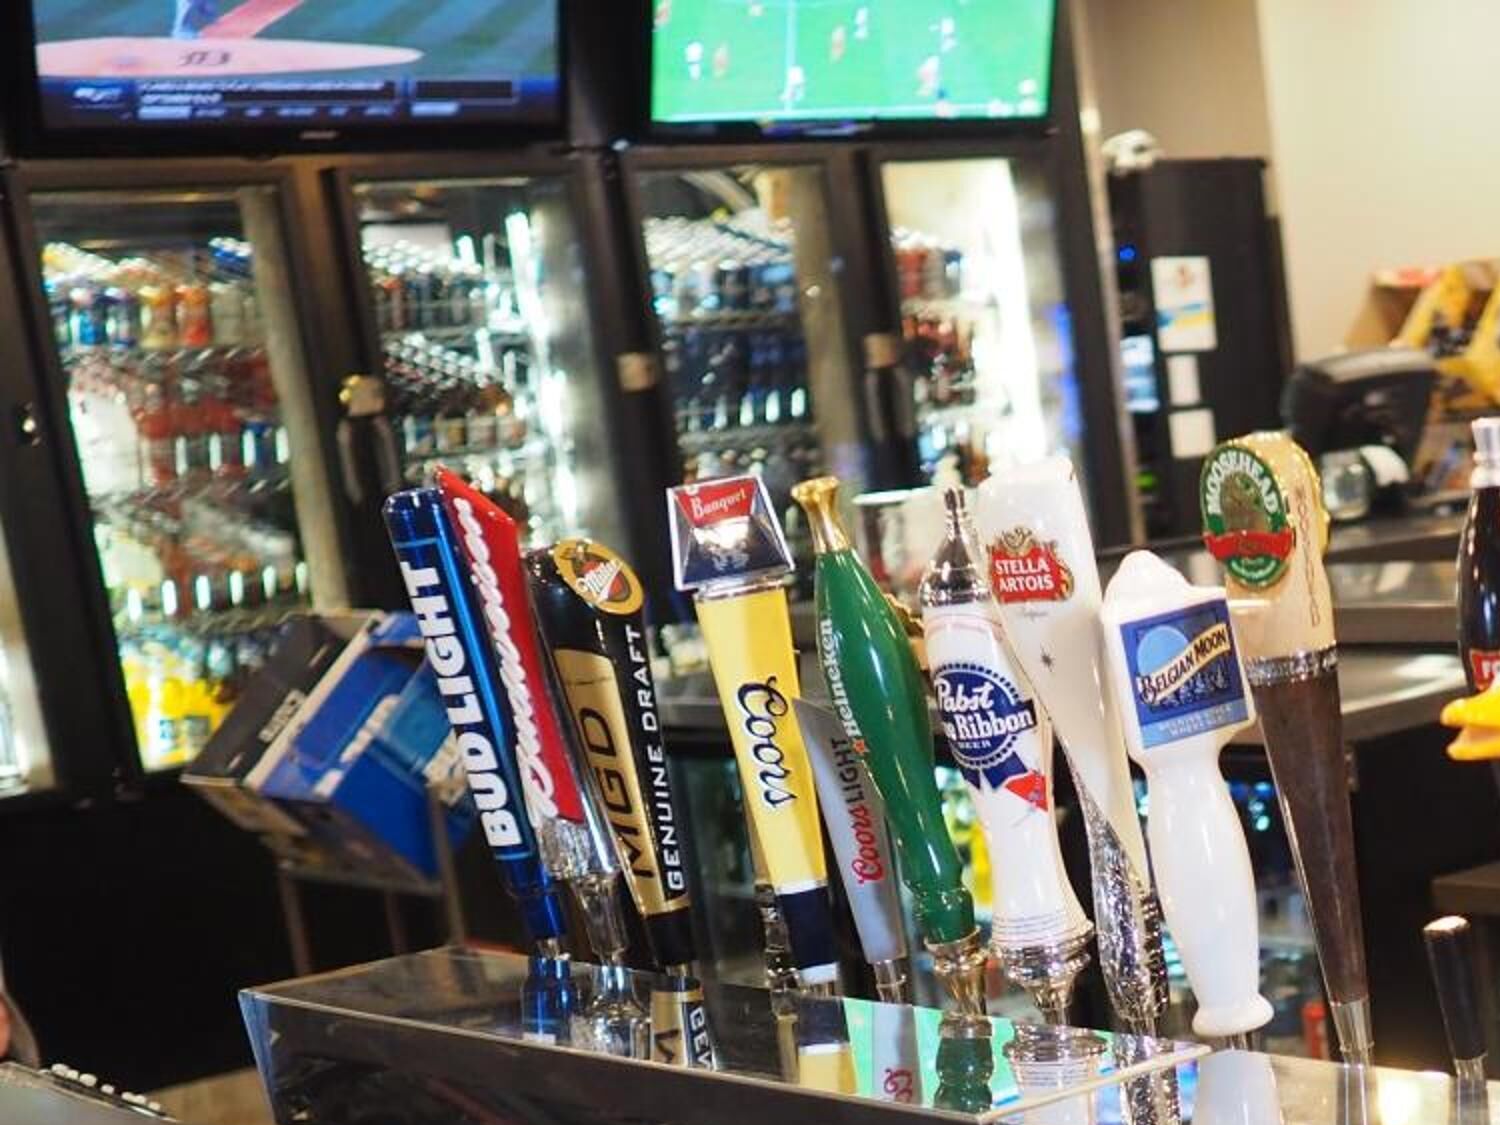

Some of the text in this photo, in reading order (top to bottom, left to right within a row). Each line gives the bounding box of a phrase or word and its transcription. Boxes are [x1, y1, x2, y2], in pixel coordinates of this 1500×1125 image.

[690, 488, 748, 518] Banquet
[1206, 450, 1280, 514] MOOSEHEAD
[995, 558, 1051, 575] STELLA
[998, 575, 1055, 593] ARTOIS
[400, 560, 523, 848] BUD LIGHT
[819, 618, 860, 740] Heineken
[935, 677, 995, 713] Pabst
[1139, 629, 1228, 705] BELGIAN MOON
[624, 623, 685, 891] GENUINE DRAFT
[737, 675, 798, 810] Coors
[953, 708, 1034, 741] Ribbon
[579, 706, 655, 879] MGD
[831, 738, 885, 887] Coors LIGHT
